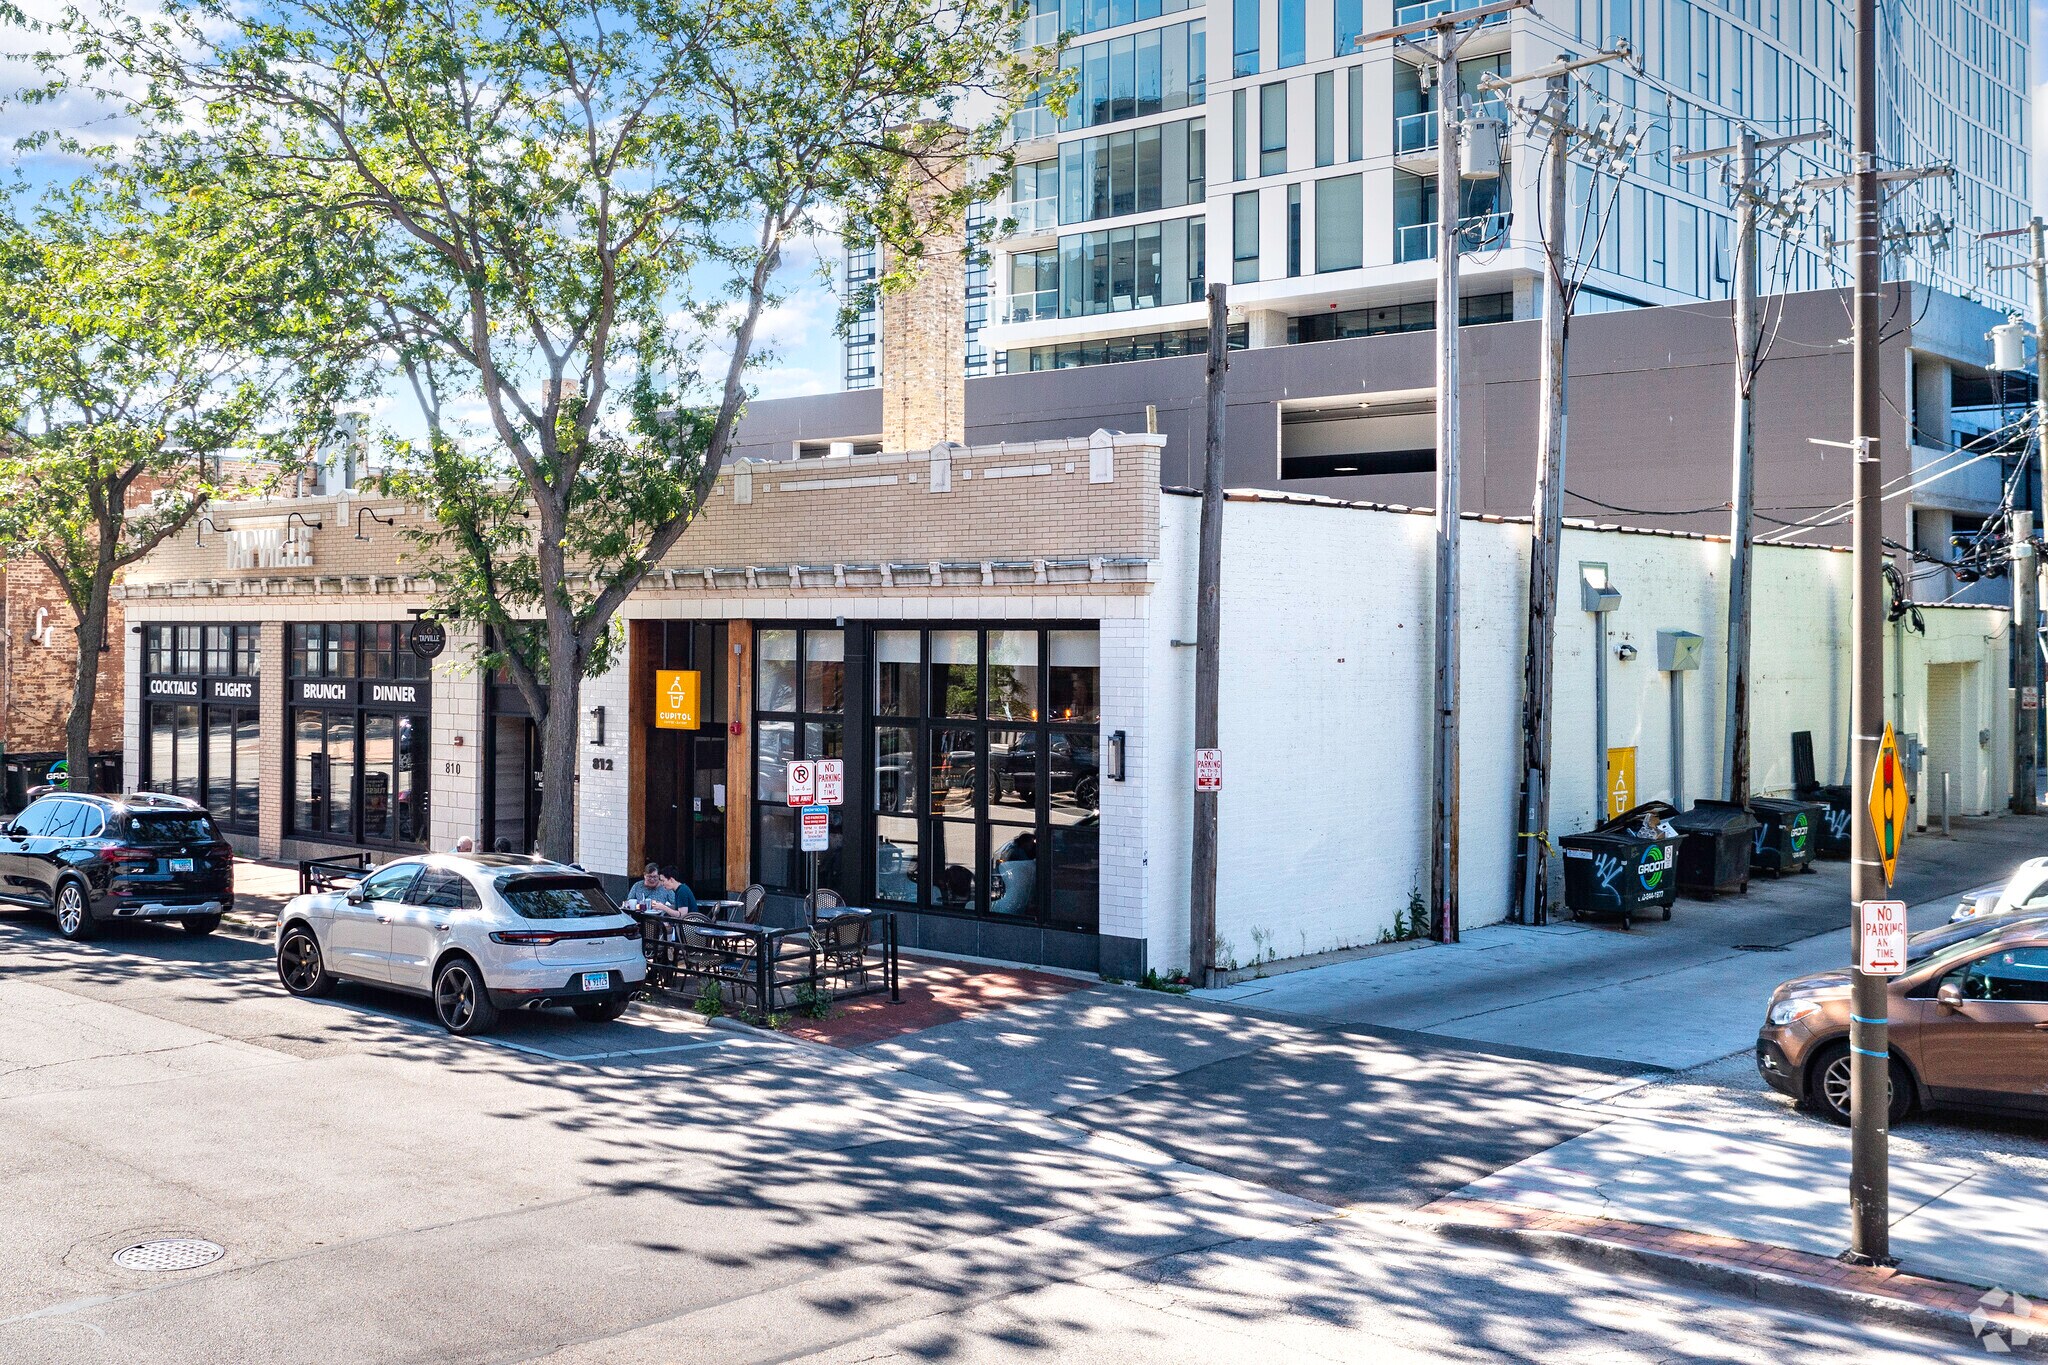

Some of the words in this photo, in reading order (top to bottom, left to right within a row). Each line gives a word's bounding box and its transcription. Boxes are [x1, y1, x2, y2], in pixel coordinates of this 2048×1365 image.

[150, 680, 198, 696] COCKTAILS
[214, 682, 252, 698] FLIGHTS
[303, 684, 346, 700] BRUNCH
[373, 685, 416, 702] DINNER
[660, 712, 692, 720] CUPITOL
[1204, 752, 1214, 760] NO
[446, 762, 460, 774] 810
[592, 758, 613, 770] 812
[824, 764, 834, 772] NO
[818, 774, 841, 782] PARKING
[1791, 826, 1808, 837] GROOT
[1638, 860, 1666, 874] GROOT
[1877, 908, 1892, 921] NO
[1866, 923, 1903, 936] PARKING
[1877, 938, 1888, 947] AN
[1877, 949, 1894, 958] TIME
